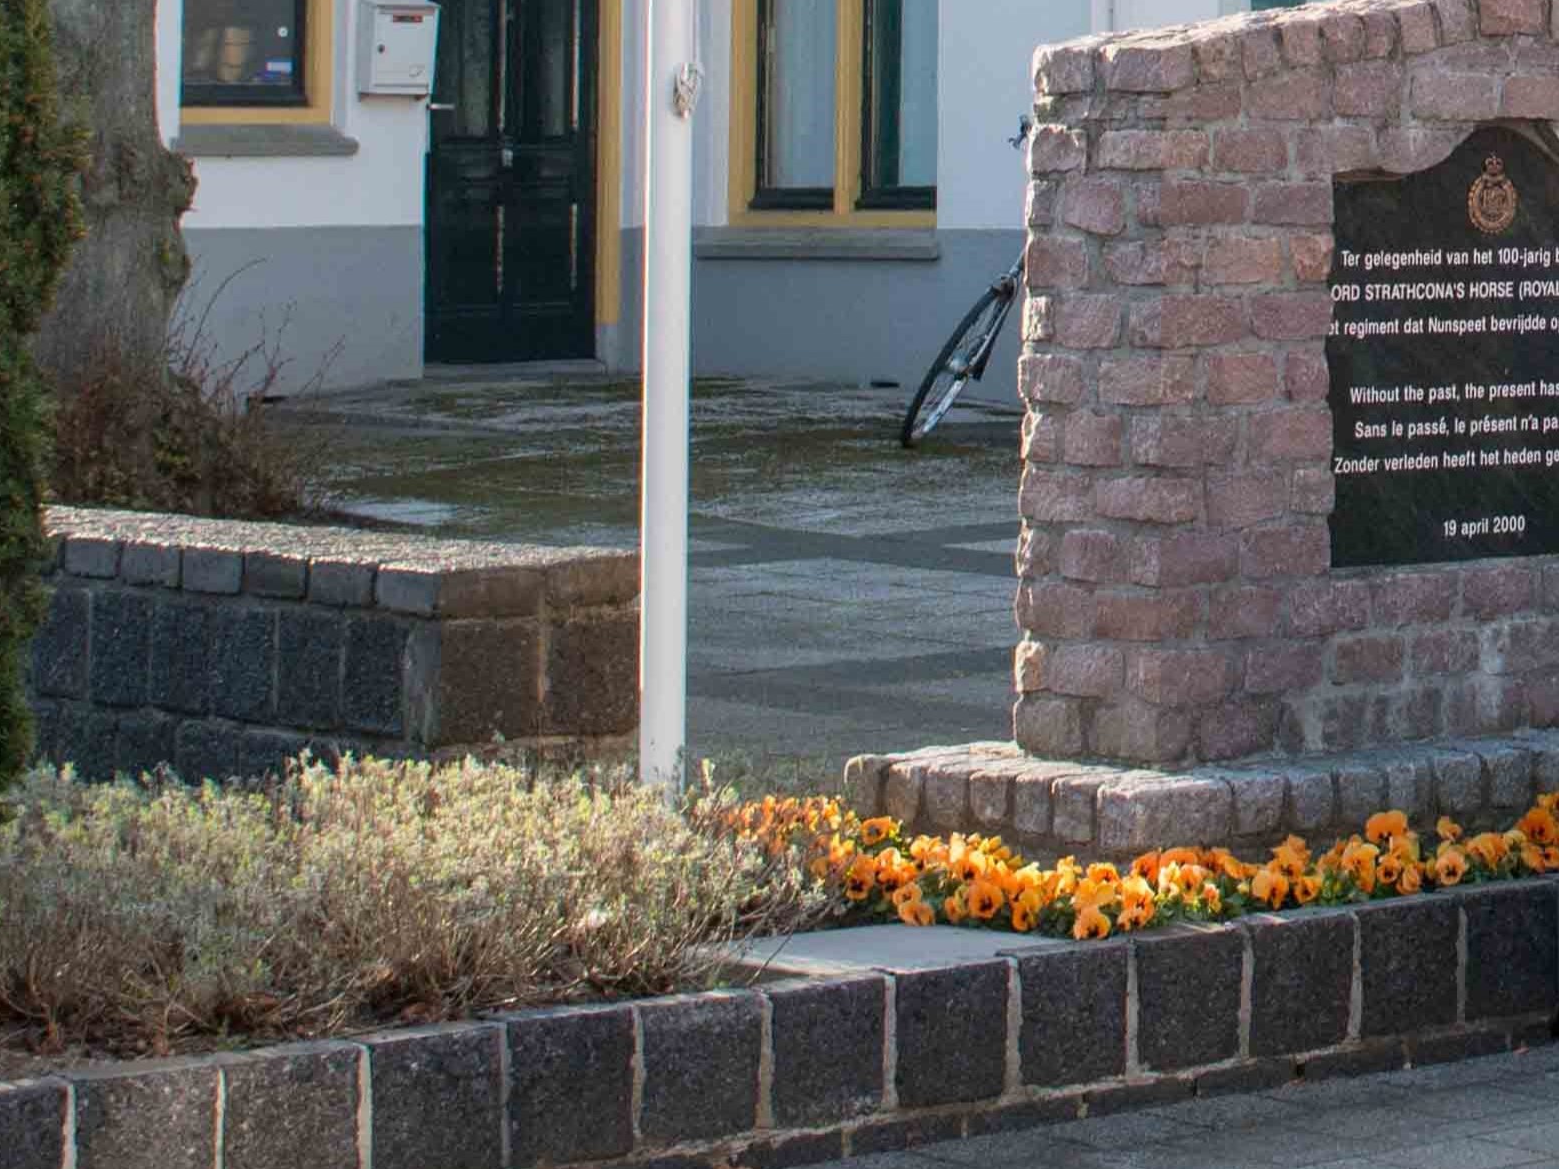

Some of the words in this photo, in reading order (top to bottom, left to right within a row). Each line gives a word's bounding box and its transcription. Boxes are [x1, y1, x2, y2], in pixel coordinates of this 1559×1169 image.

[1341, 250, 1360, 267] Ter
[1365, 248, 1442, 270] gelegenheid
[1446, 251, 1469, 265] van
[1473, 248, 1493, 264] het
[1497, 247, 1551, 268] 100-jarig
[1330, 284, 1360, 301] ORD
[1365, 282, 1465, 301] STRATHCONA'S
[1469, 281, 1514, 298] HORSE
[1344, 317, 1399, 339] regiment
[1403, 317, 1423, 334] dat
[1428, 316, 1486, 336] Nunspeet
[1490, 314, 1546, 334] bevrijdde
[1350, 385, 1400, 404] Without
[1404, 384, 1424, 401] the
[1428, 384, 1460, 404] past,
[1465, 382, 1485, 399] the
[1489, 381, 1536, 402] present
[1355, 421, 1387, 438] Sans
[1392, 420, 1403, 436] le
[1408, 416, 1450, 439] passé,
[1454, 417, 1466, 434] le
[1470, 414, 1517, 437] présent
[1334, 456, 1379, 474] Zonder
[1384, 452, 1439, 471] verleden
[1442, 450, 1475, 468] heeft
[1480, 449, 1499, 466] het
[1503, 446, 1541, 465] heden
[1443, 519, 1457, 536] 19
[1461, 517, 1489, 539] april
[1493, 514, 1526, 533] 2000
